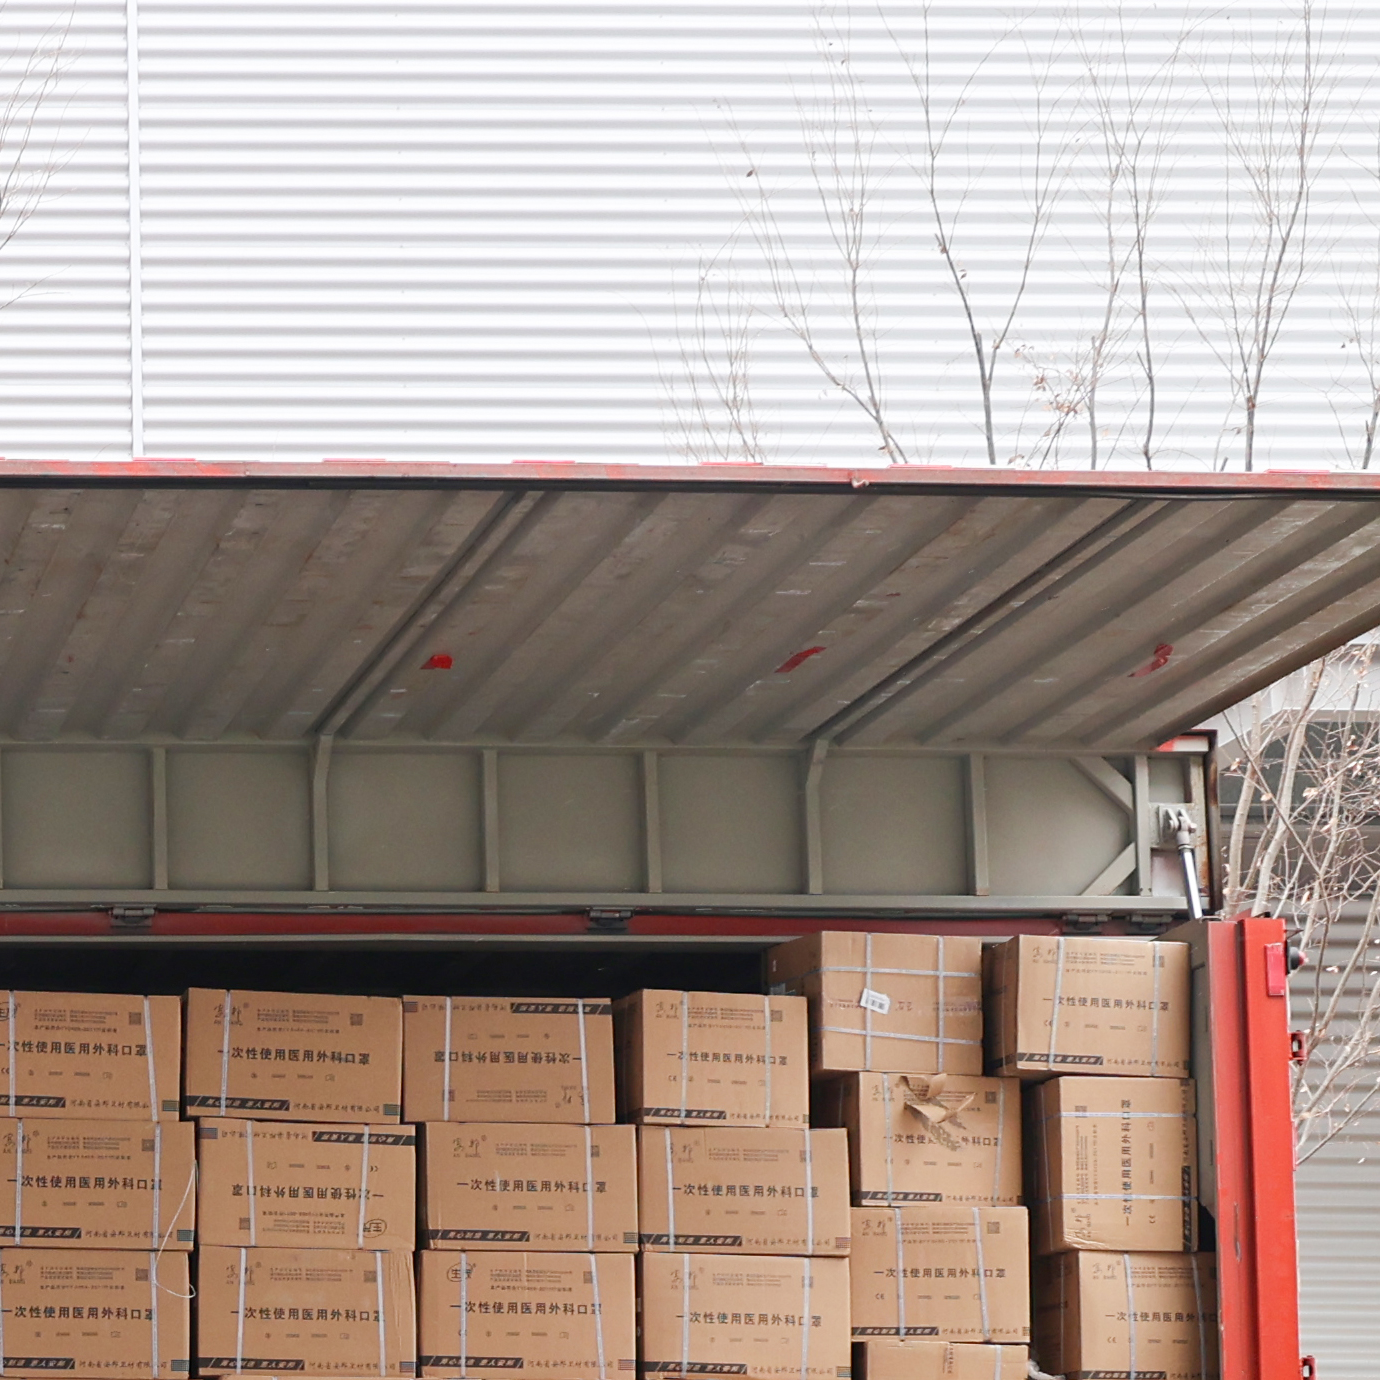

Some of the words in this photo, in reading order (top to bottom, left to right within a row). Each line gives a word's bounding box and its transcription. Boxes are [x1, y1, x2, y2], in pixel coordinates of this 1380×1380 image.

[434, 1050, 583, 1064] 一次性使用医用外科口罩
[670, 1183, 819, 1198] 一次性使用医用外科口罩
[0, 1305, 155, 1320] 一次性使用医用外科口罩
